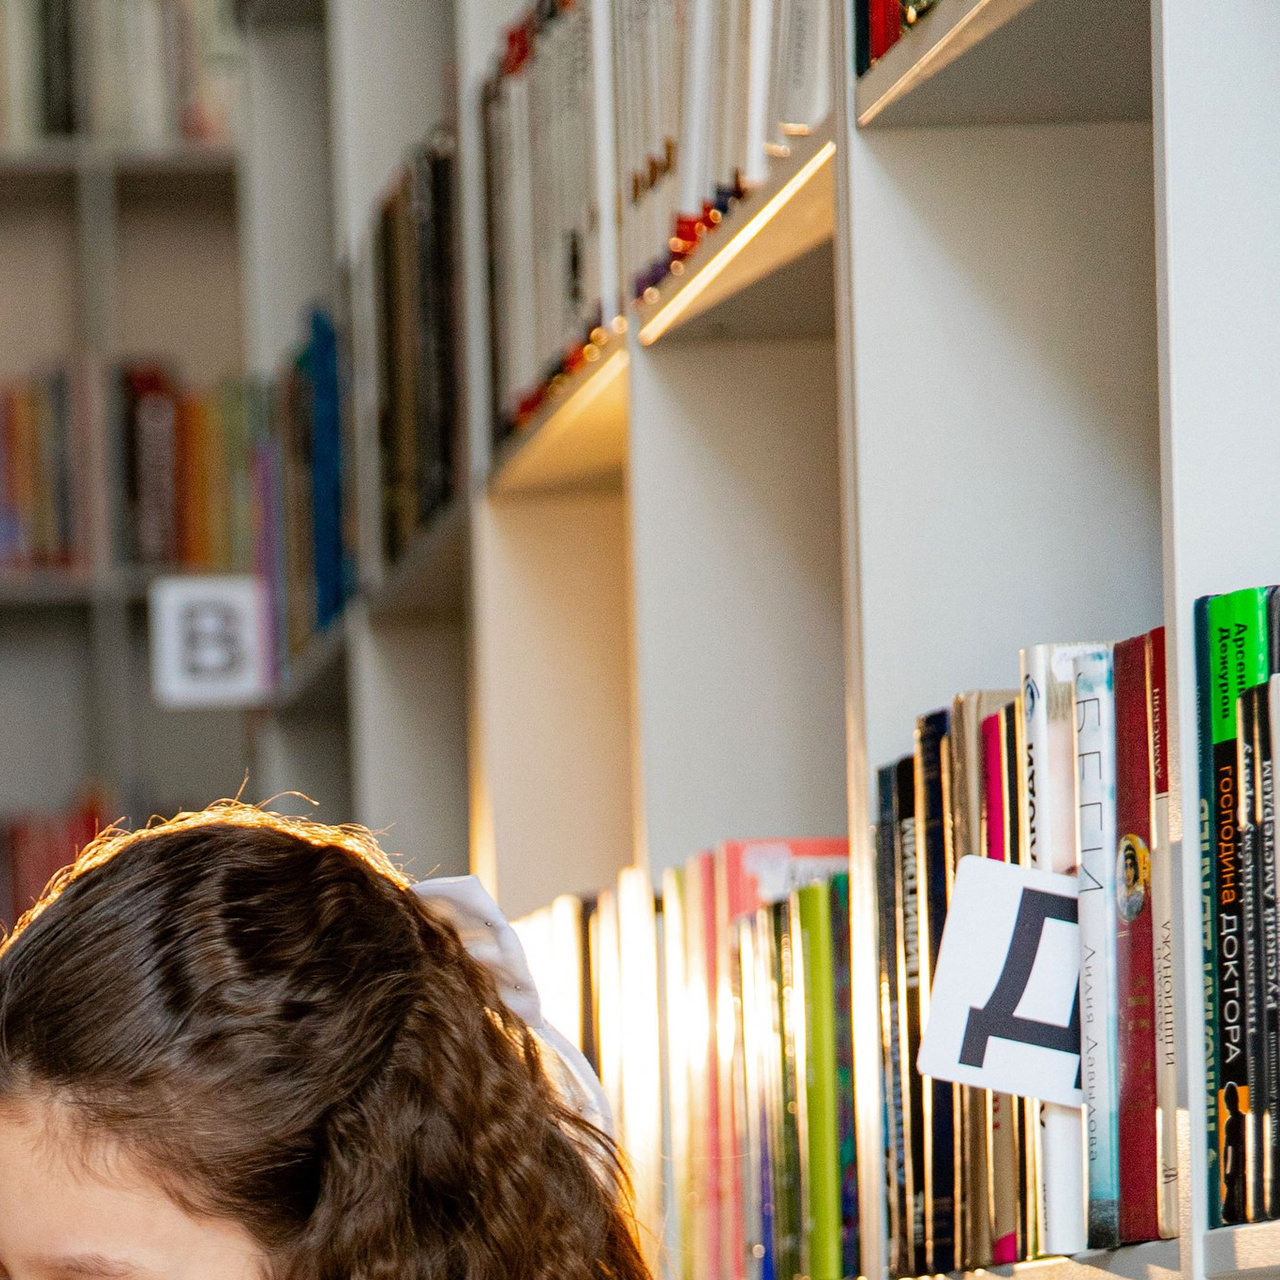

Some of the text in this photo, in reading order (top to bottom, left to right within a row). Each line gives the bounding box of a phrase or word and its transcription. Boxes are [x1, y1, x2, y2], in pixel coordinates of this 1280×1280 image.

[184, 601, 245, 681] В
[1217, 626, 1232, 720] Дежуров
[900, 816, 919, 987] ПИЛИГРИМ
[1261, 759, 1279, 1010] Русский Амстердам
[958, 887, 1081, 1090] Д
[1084, 944, 1098, 1162] Лилия Давыдова
[1161, 919, 1174, 1045] ШПИОНАЖА
[1220, 913, 1241, 1065] ДОКТОРА
